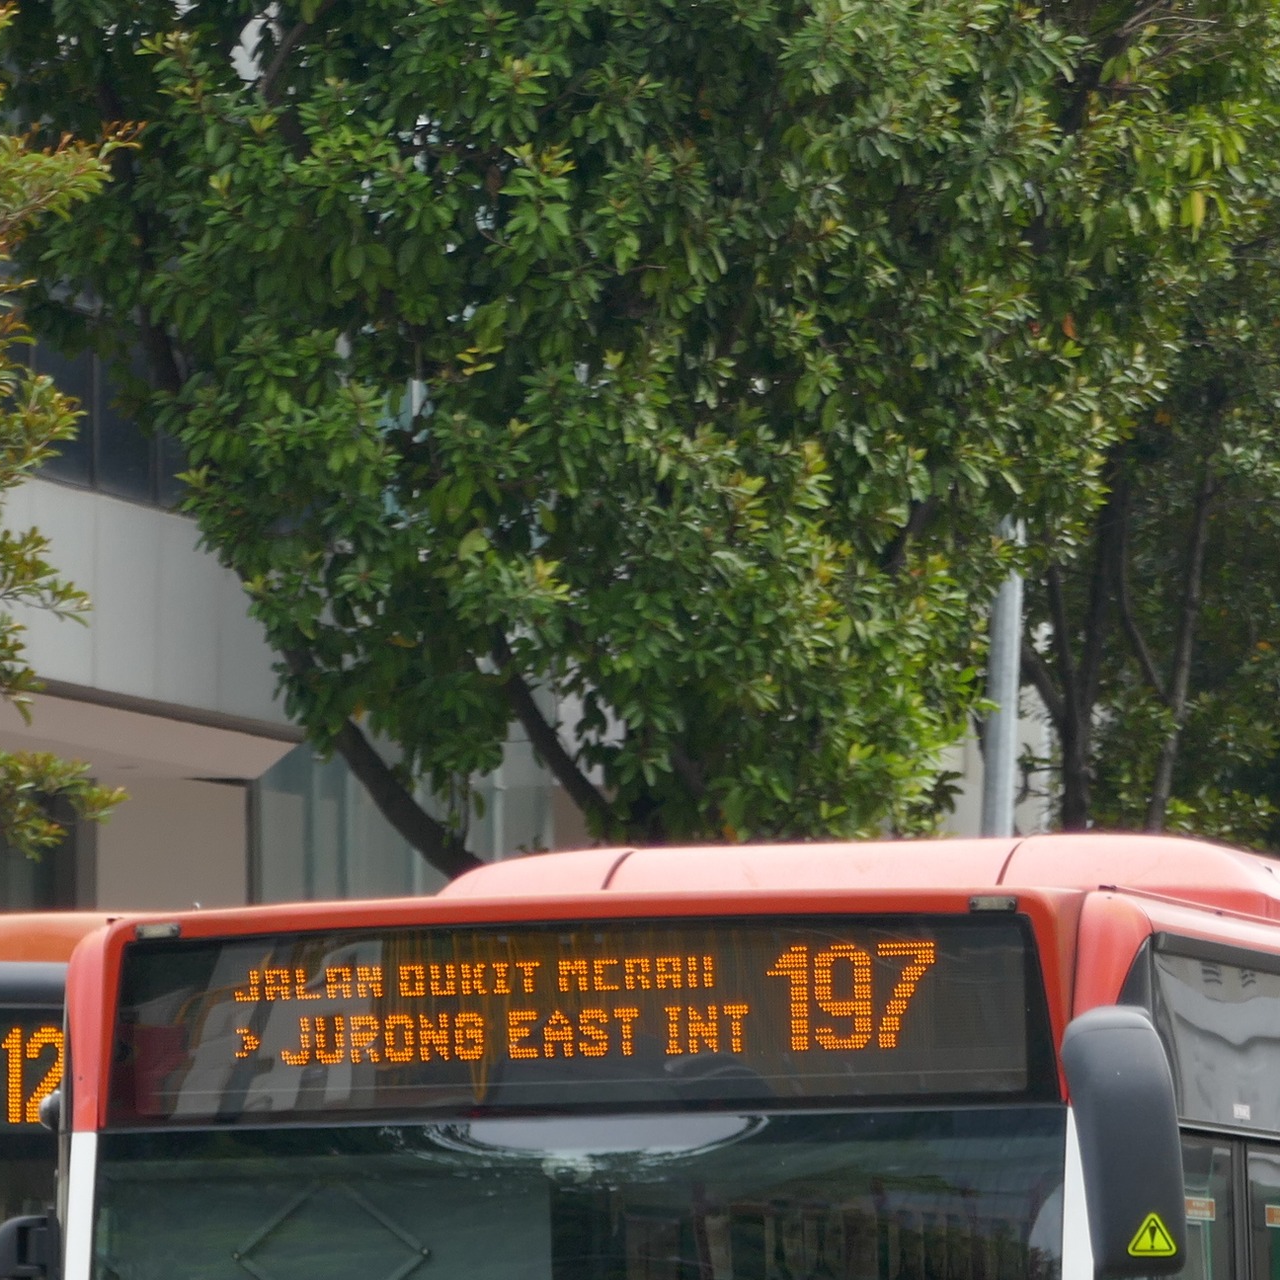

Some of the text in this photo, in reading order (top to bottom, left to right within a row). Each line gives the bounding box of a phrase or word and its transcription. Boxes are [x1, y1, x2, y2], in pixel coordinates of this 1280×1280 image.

[234, 965, 383, 1001] JALAN
[766, 942, 936, 1051] 197
[281, 1004, 749, 1065] JURONG EAST INT
